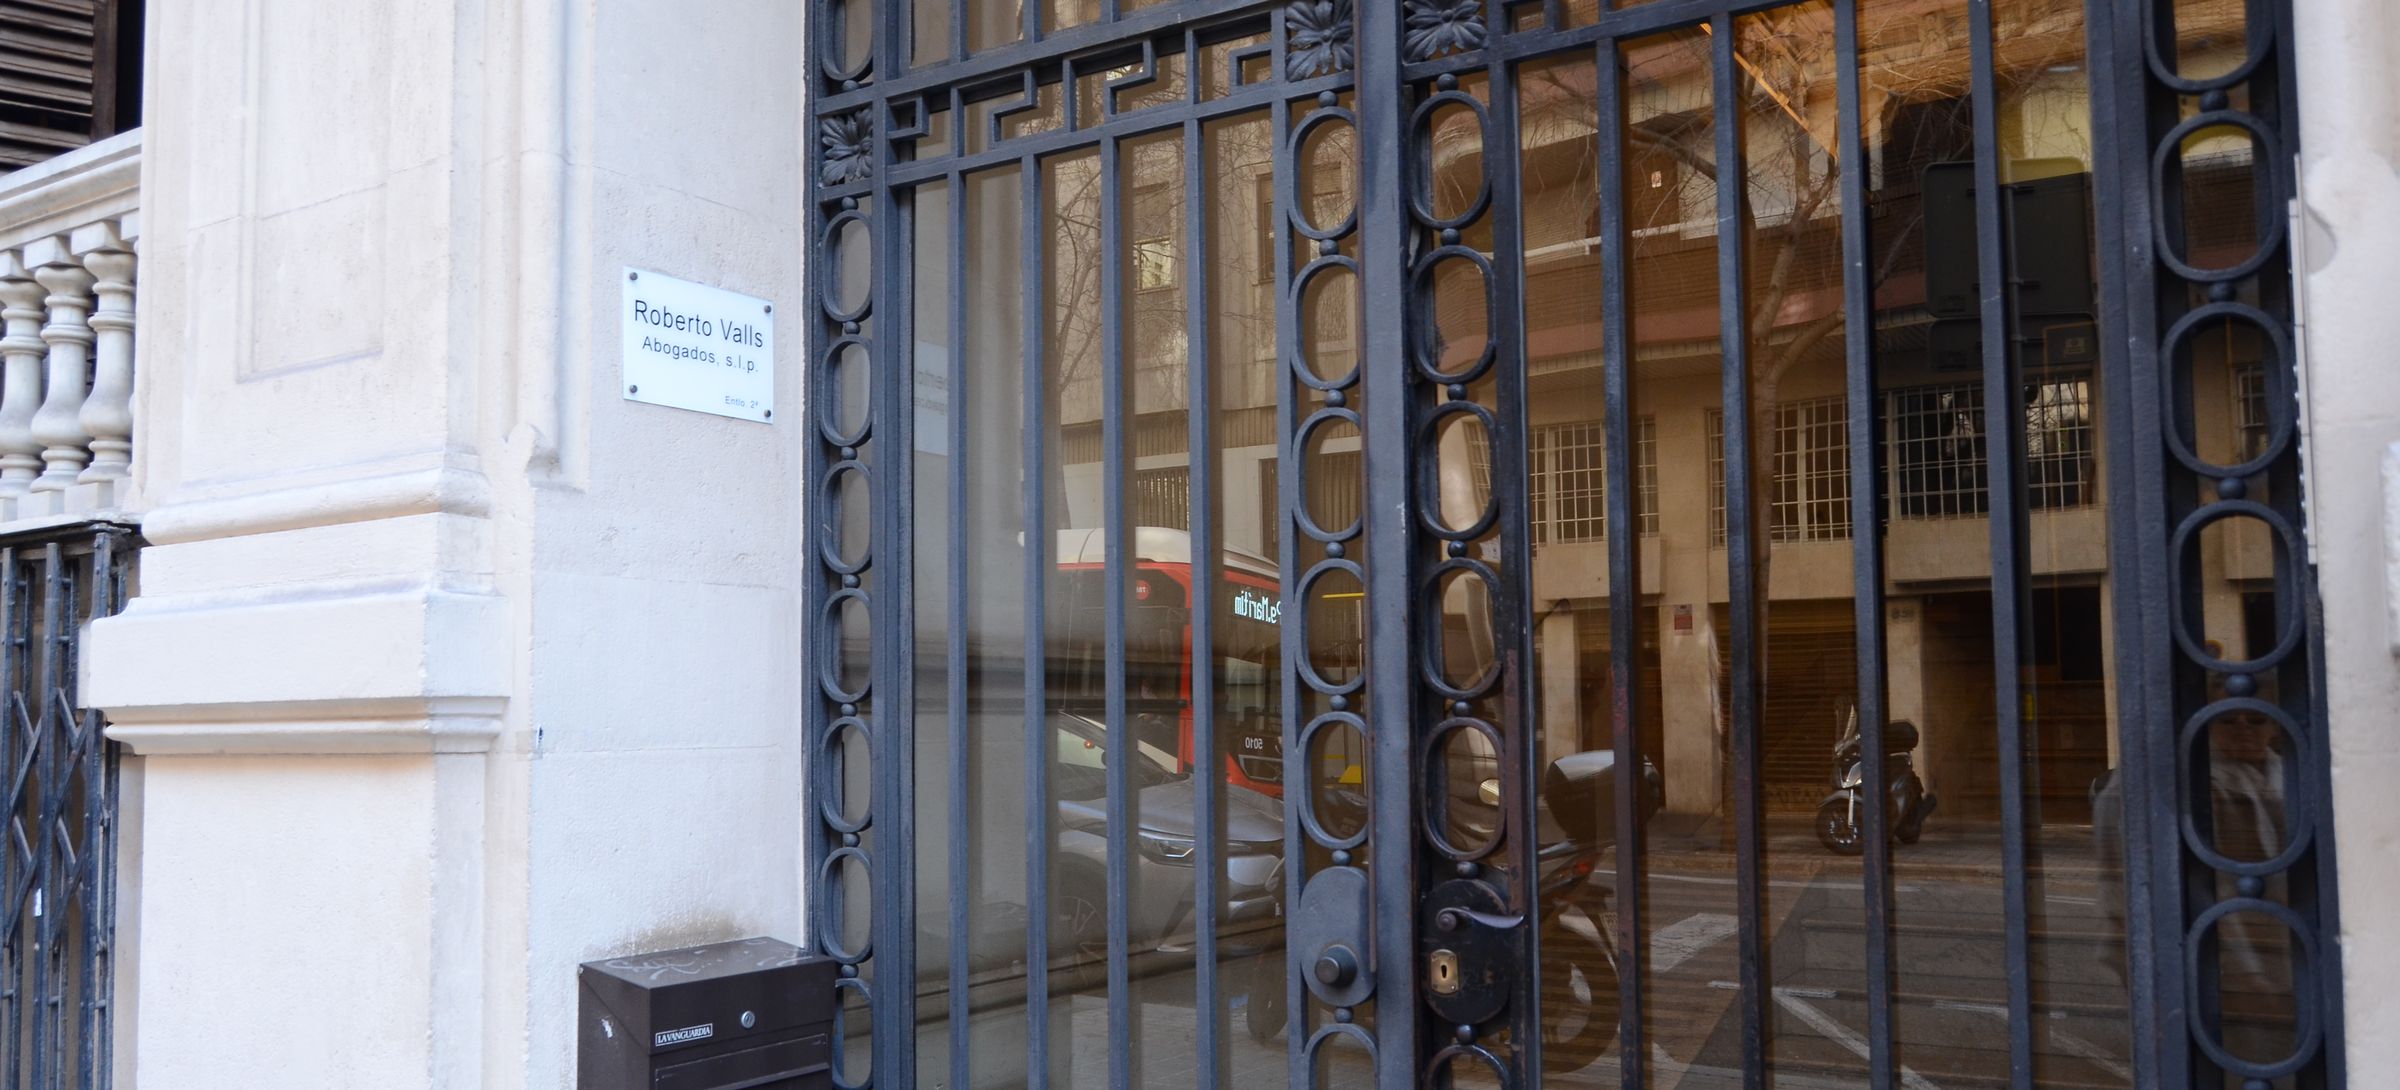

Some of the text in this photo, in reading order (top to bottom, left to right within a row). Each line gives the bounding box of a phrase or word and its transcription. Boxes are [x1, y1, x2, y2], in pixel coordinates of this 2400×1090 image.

[634, 299, 763, 348] Roberto Valls
[642, 335, 759, 374] Abogados, s.l.p.
